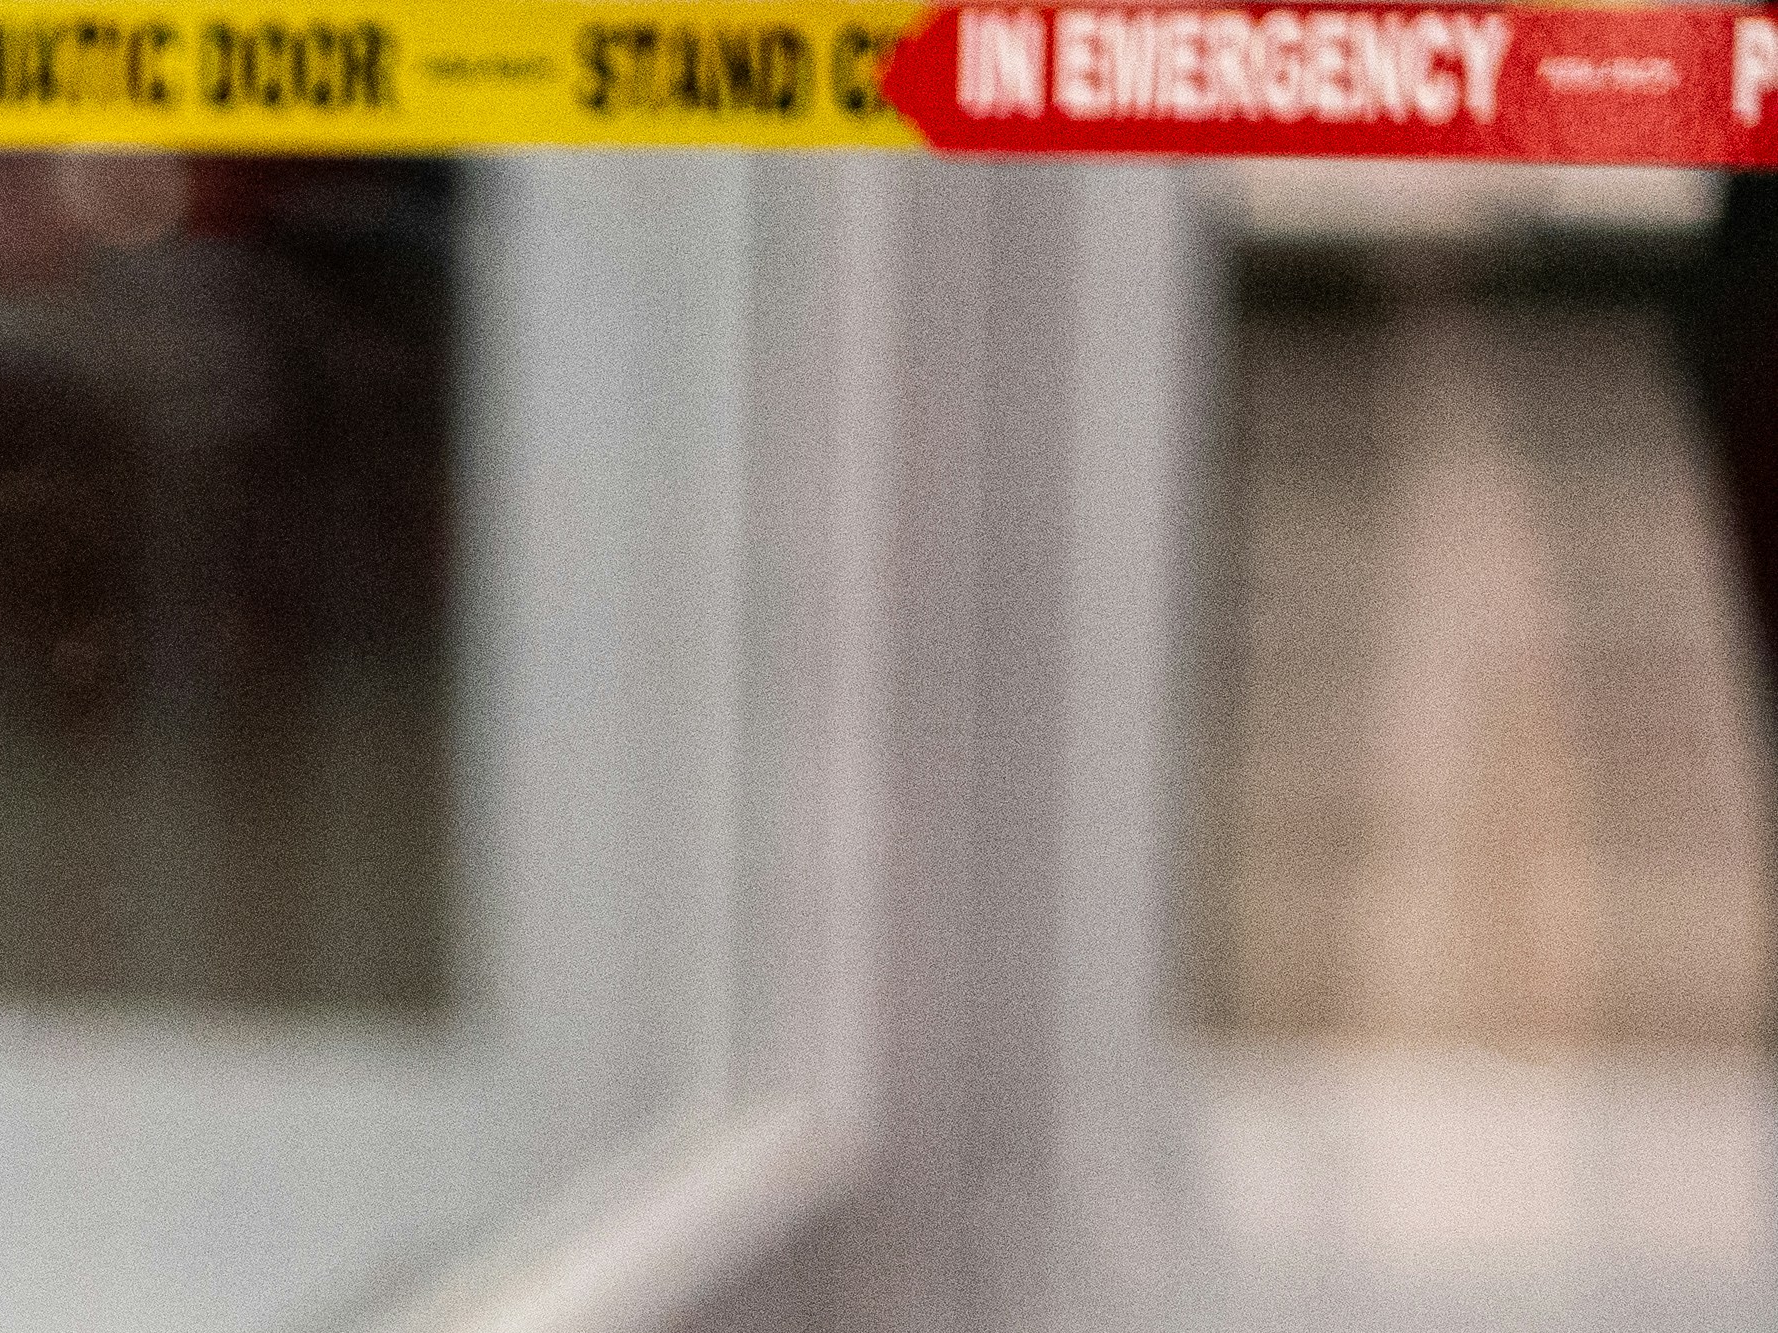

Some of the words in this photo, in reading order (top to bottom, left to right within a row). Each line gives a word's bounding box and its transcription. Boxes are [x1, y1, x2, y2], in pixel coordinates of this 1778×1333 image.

[201, 19, 399, 111] DOOR
[573, 20, 814, 119] STAND
[953, 7, 1047, 119] IN
[1051, 7, 1513, 126] EMERGENCY
[1731, 14, 1778, 127] P
